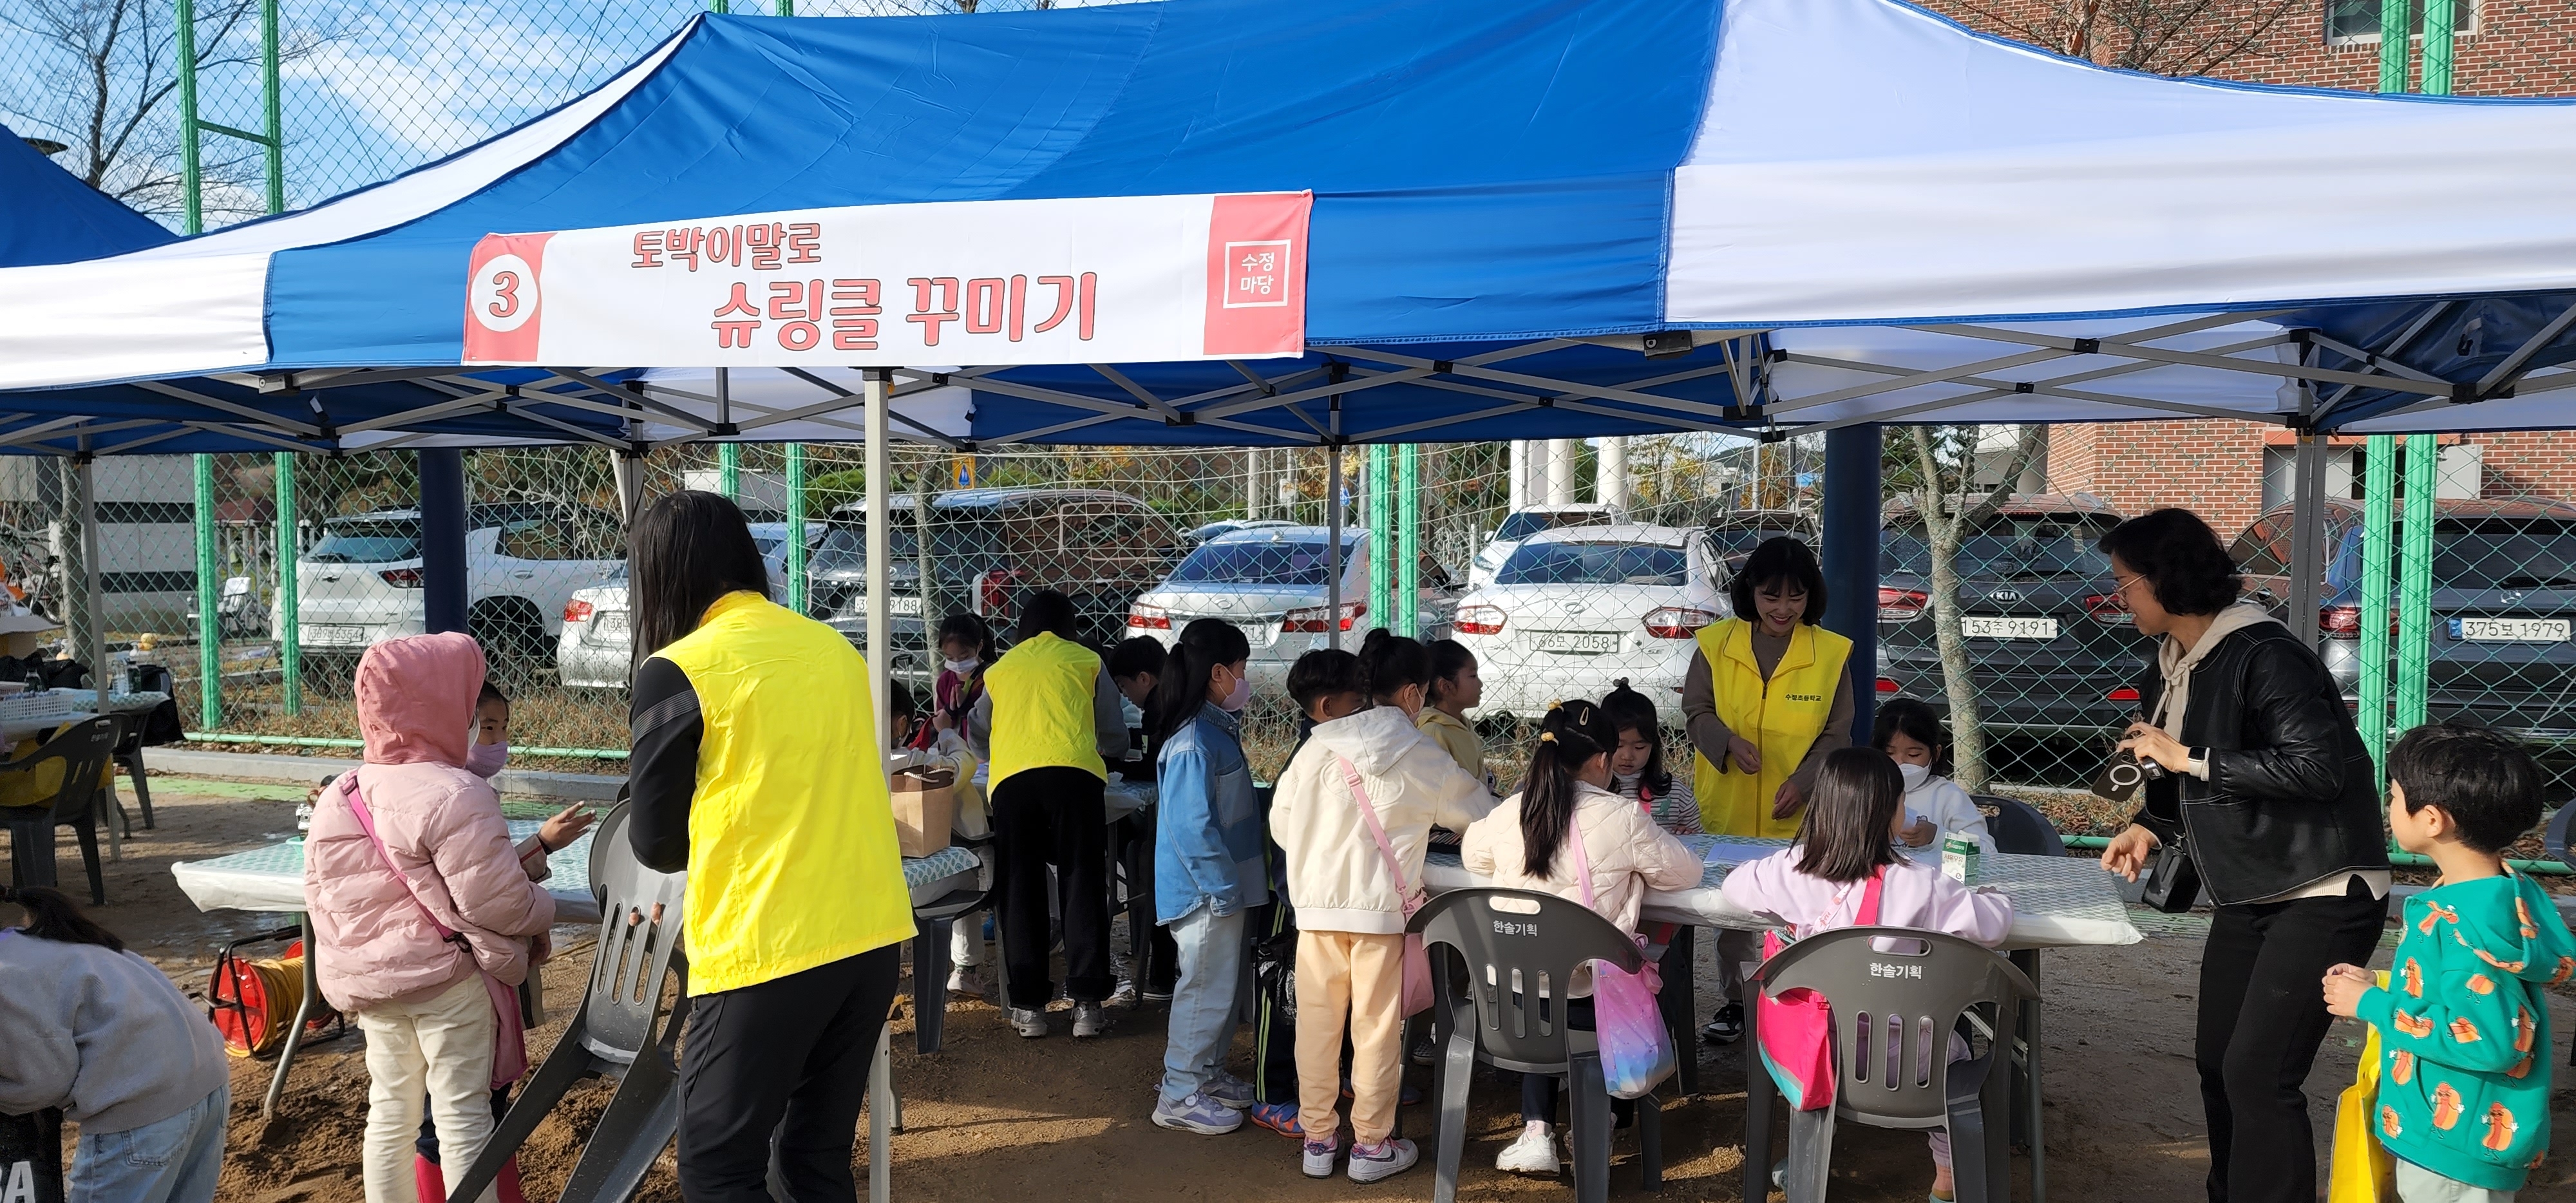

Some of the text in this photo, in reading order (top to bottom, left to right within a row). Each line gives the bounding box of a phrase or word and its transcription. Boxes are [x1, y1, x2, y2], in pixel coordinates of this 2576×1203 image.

[631, 222, 821, 272] 토박이말로
[1241, 252, 1274, 272] 수정
[488, 270, 520, 318] 3
[1240, 274, 1274, 294] 마당
[711, 271, 1097, 351] 슈링클 꾸미기
[1995, 591, 2017, 601] KIA
[2465, 621, 2564, 638] 375보 1979
[1572, 635, 1609, 649] 2058
[1493, 920, 1538, 937] 한솔기획
[1869, 962, 1922, 980] 한솔기획
[0, 1161, 36, 1203] A
